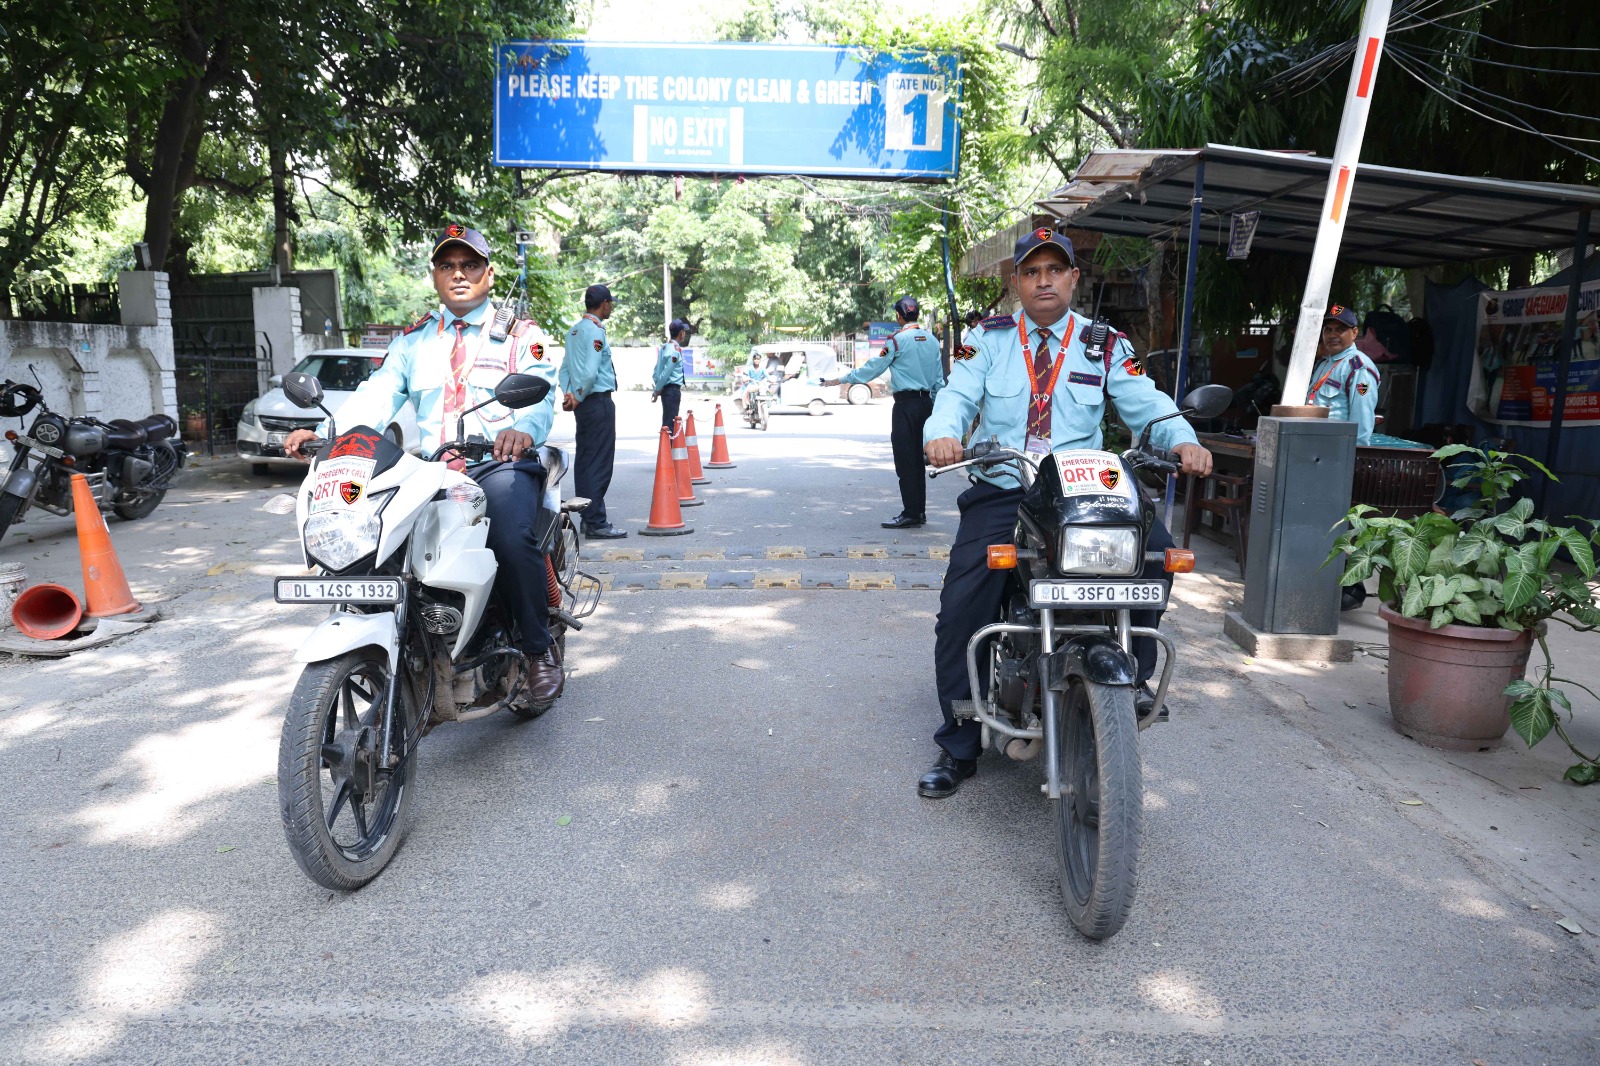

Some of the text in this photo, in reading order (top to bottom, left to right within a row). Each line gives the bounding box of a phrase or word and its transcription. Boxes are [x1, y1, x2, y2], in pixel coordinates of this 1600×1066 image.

[508, 74, 872, 105] PLEASE KEEP THE COLONY CLEAN & GREEN
[904, 93, 928, 145] 1
[650, 116, 727, 147] NO EXIT
[1525, 293, 1568, 316] SAFEGUARD
[1565, 396, 1587, 406] CHOOSE
[1588, 395, 1598, 406] US
[1062, 458, 1118, 468] EMERGENCY CALL
[318, 468, 366, 480] EMERGENCY CALL
[1063, 467, 1095, 483] QRT
[314, 480, 339, 500] QRT
[294, 584, 393, 597] DL 14SC 1932
[1052, 586, 1160, 601] DL 3SFQ 1696
